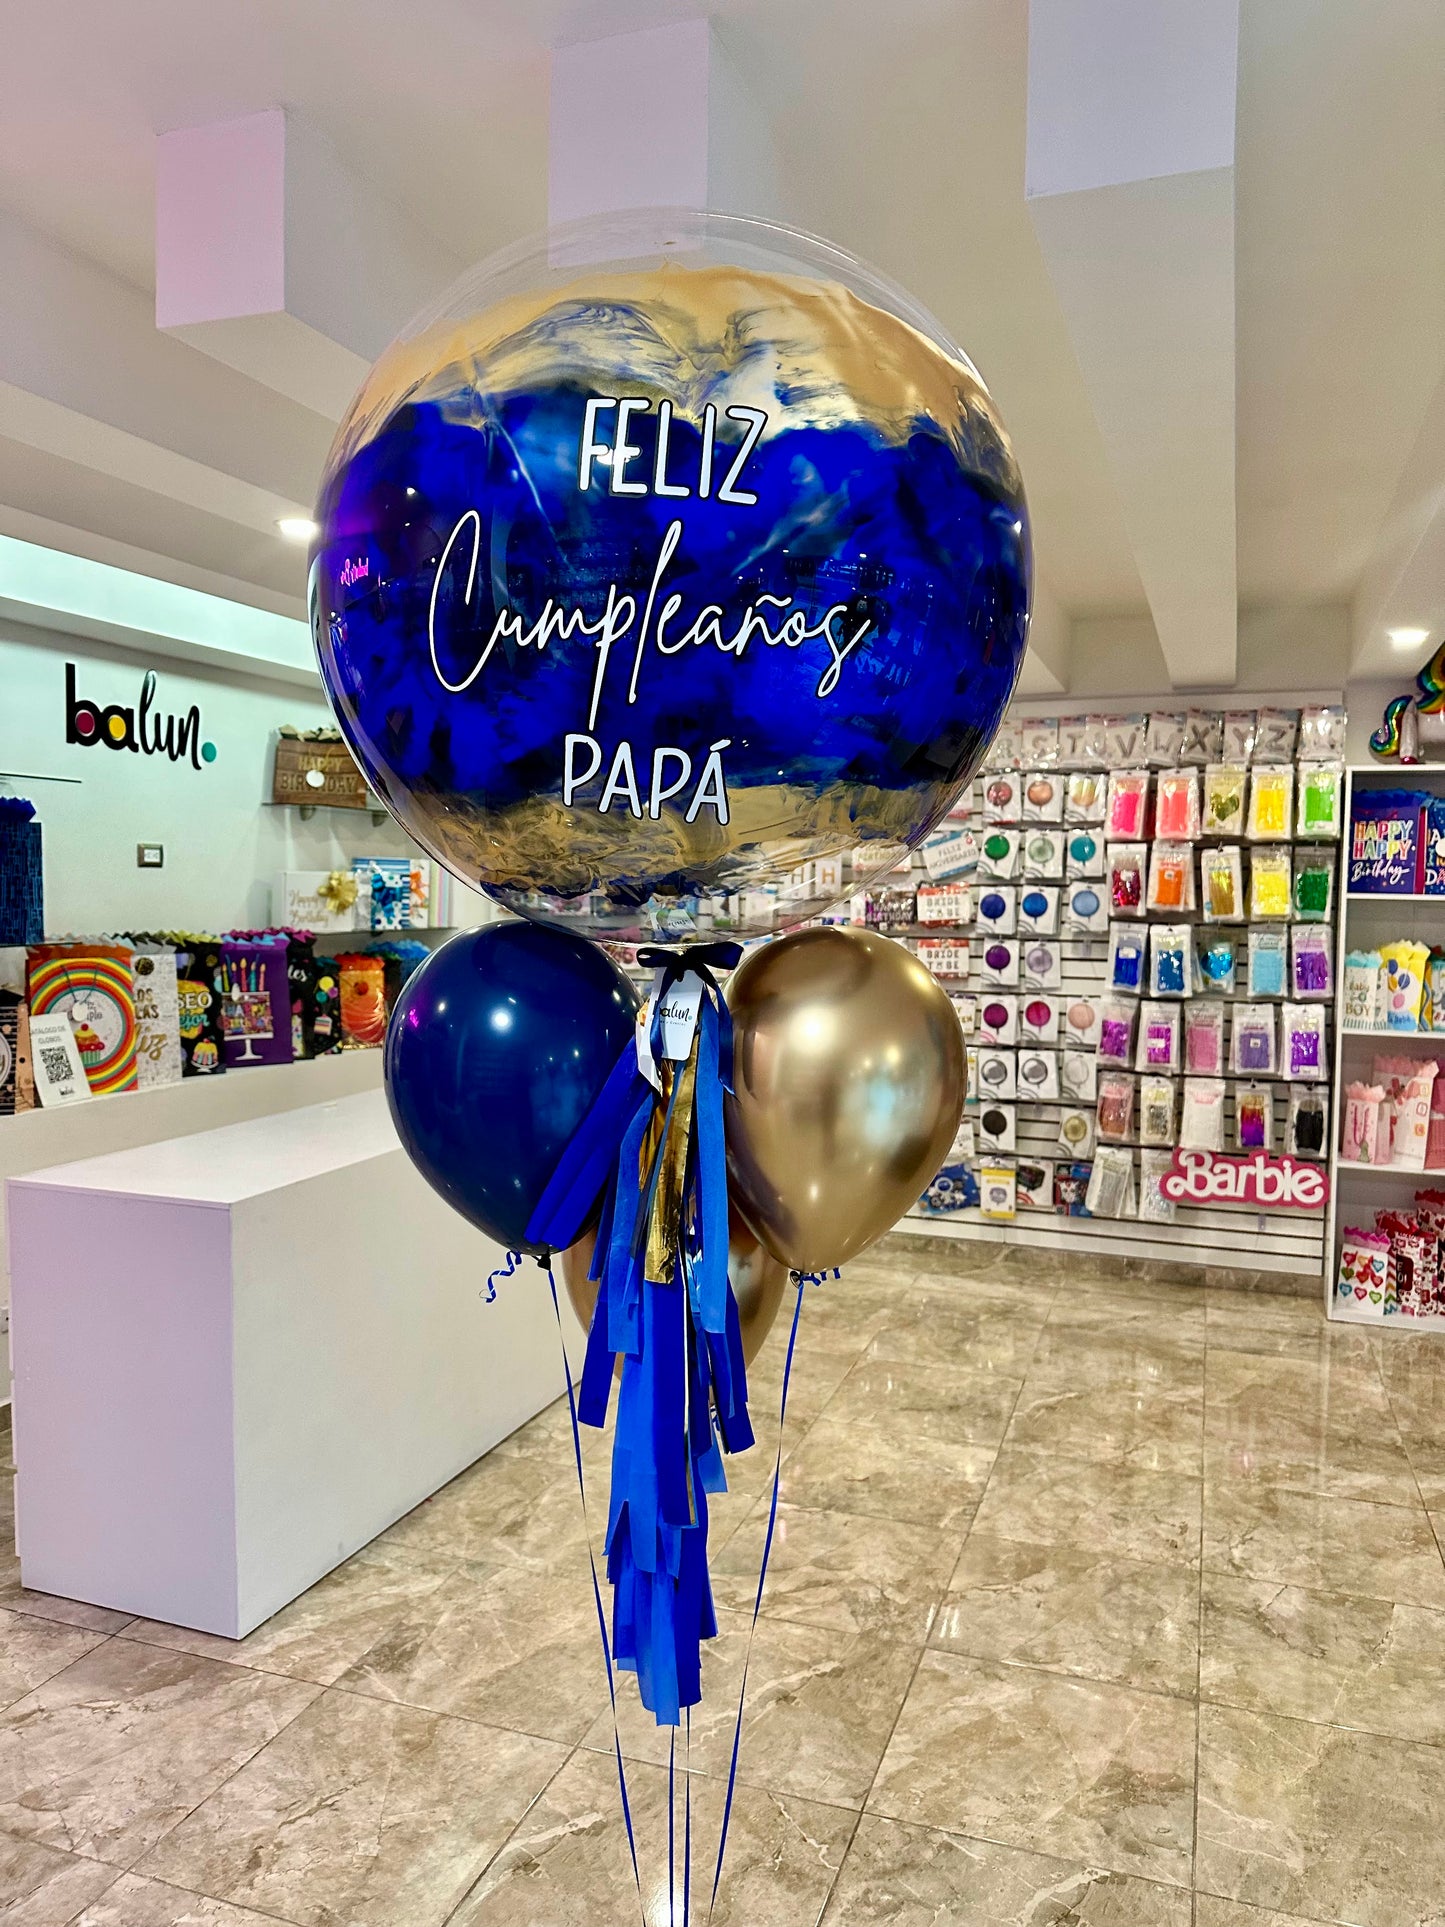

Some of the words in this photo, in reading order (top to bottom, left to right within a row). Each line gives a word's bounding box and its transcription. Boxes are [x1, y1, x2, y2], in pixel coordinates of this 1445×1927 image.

[578, 398, 768, 505] FELIZ
[428, 510, 870, 731] Cumpleaños
[1067, 733, 1084, 753] T
[1114, 731, 1137, 759] V
[1188, 724, 1210, 752] X
[1233, 727, 1252, 756] Y
[1264, 723, 1287, 751] Z
[298, 755, 345, 772] HAPPY
[280, 773, 357, 793] BIRDAY
[561, 733, 732, 825] PAPÁ
[1354, 820, 1414, 840] HAPPY
[1353, 839, 1412, 860] HAPPY
[821, 867, 835, 884] H
[1351, 859, 1410, 885] Birthday
[926, 949, 960, 959] BRIDE
[946, 960, 960, 970] BE
[1345, 1002, 1371, 1017] BOY
[1166, 1150, 1325, 1204] Barbie
